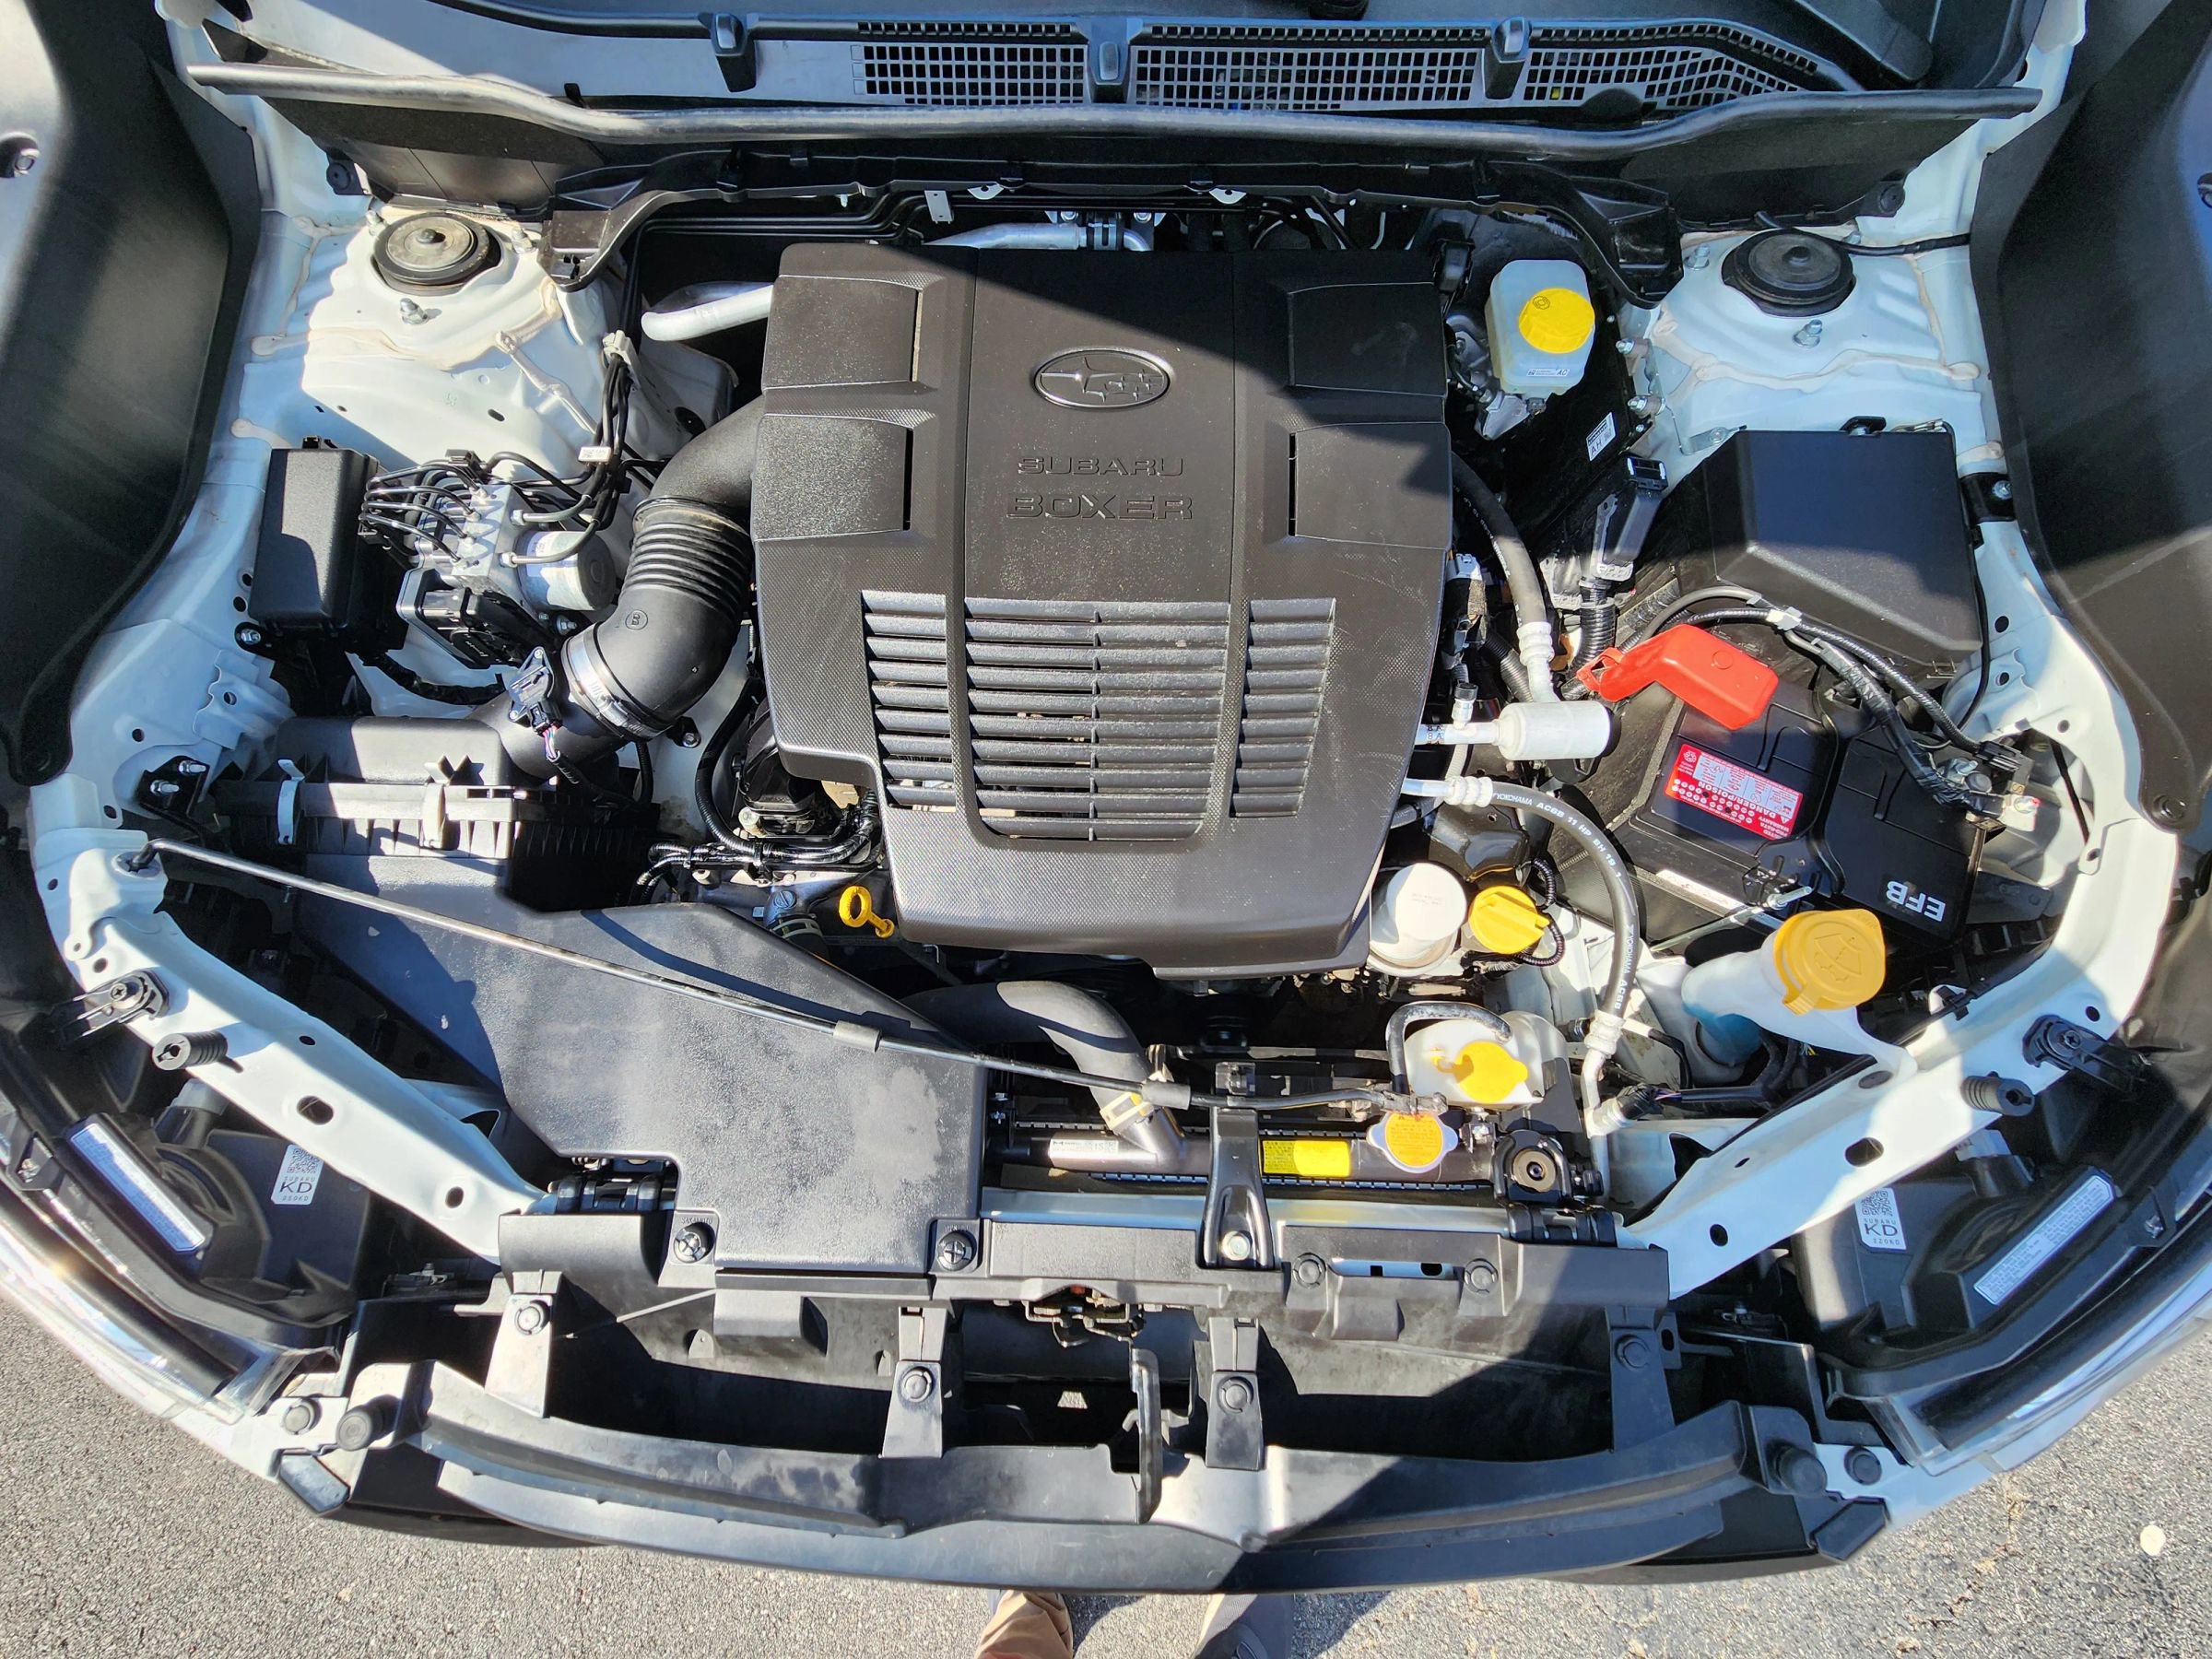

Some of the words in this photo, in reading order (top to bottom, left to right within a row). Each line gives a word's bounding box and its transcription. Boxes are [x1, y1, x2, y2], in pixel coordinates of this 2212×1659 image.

[1017, 457, 1184, 477] SUBARU
[1007, 494, 1194, 520] BOXER
[1698, 781, 1776, 818] DANGER/POISON
[1496, 794, 1533, 806] YOKOHAMA
[1578, 824, 1593, 837] HP
[1886, 880, 1946, 922] EFB
[279, 1181, 312, 1194] KD
[1864, 1223, 1899, 1236] KD
